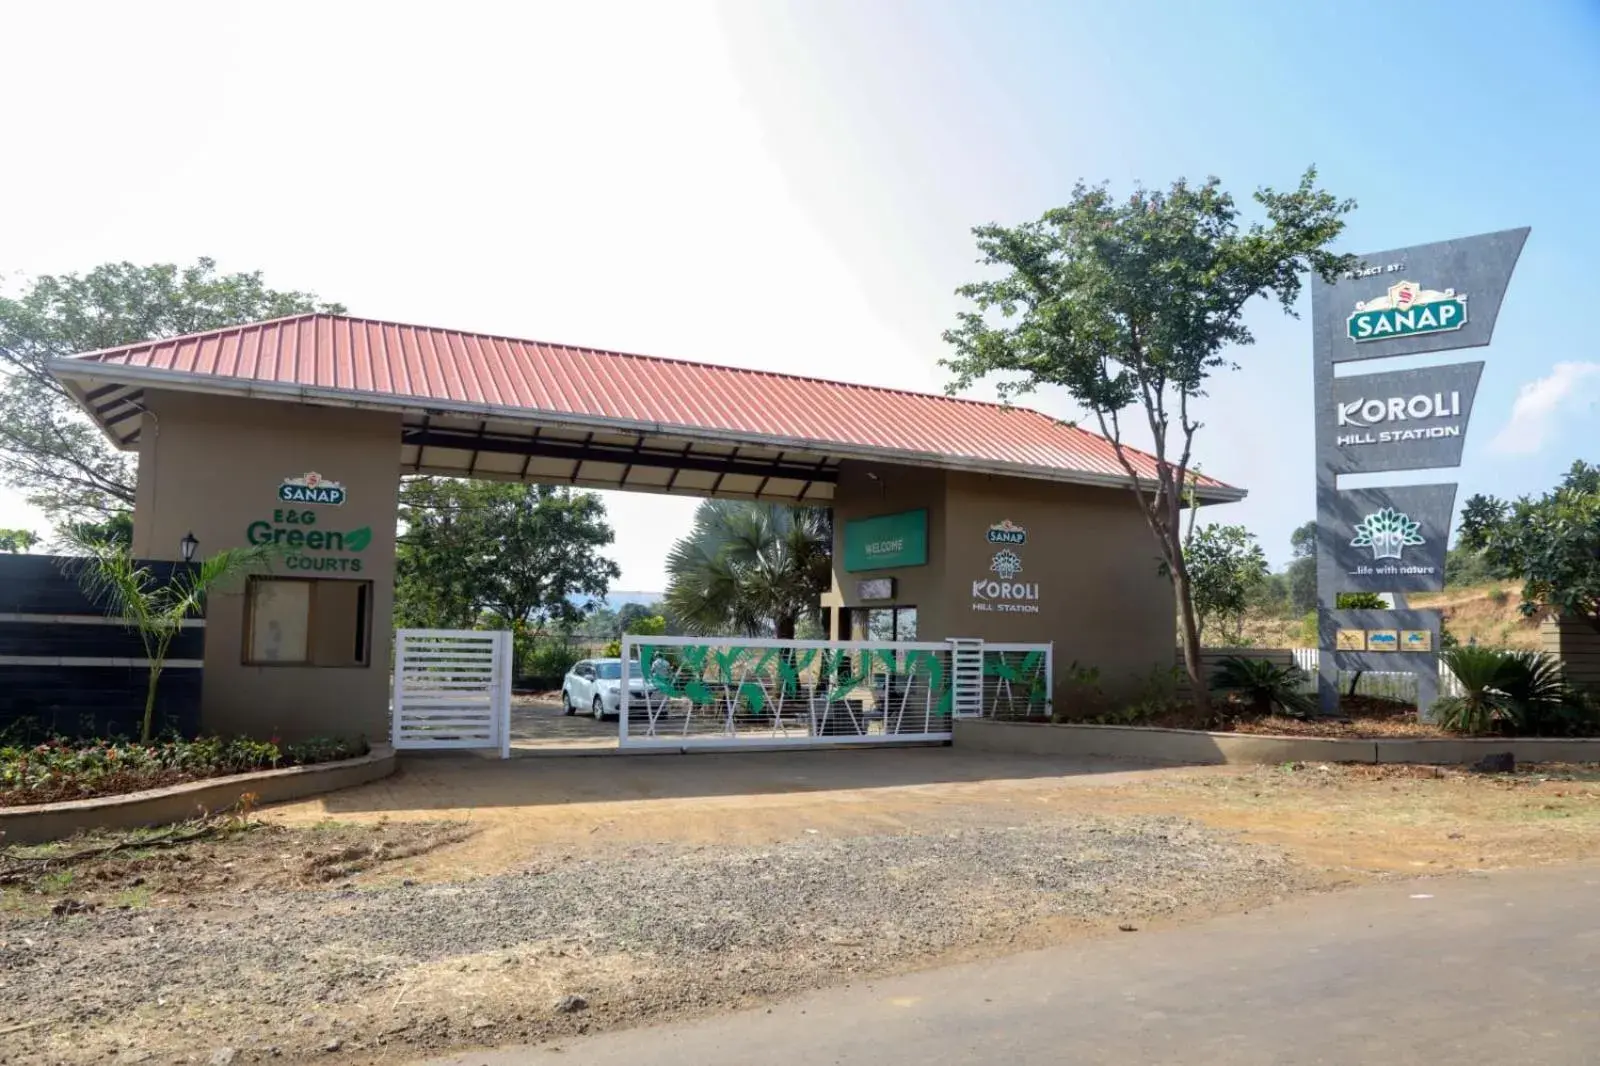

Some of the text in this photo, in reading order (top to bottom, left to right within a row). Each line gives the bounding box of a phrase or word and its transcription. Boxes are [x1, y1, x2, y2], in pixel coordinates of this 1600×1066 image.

[1357, 304, 1456, 337] SANAP
[1337, 391, 1460, 428] KOROLI
[1337, 425, 1460, 447] HILL STATION
[283, 487, 340, 502] SANAP
[247, 520, 344, 551] Green
[990, 531, 1024, 543] SANAP
[865, 538, 903, 555] WELCOME
[285, 556, 362, 572] COURTS
[1375, 564, 1398, 575] with
[1400, 565, 1435, 575] nature
[972, 578, 1039, 601] KOROLI
[972, 603, 1039, 613] HILL STATION
